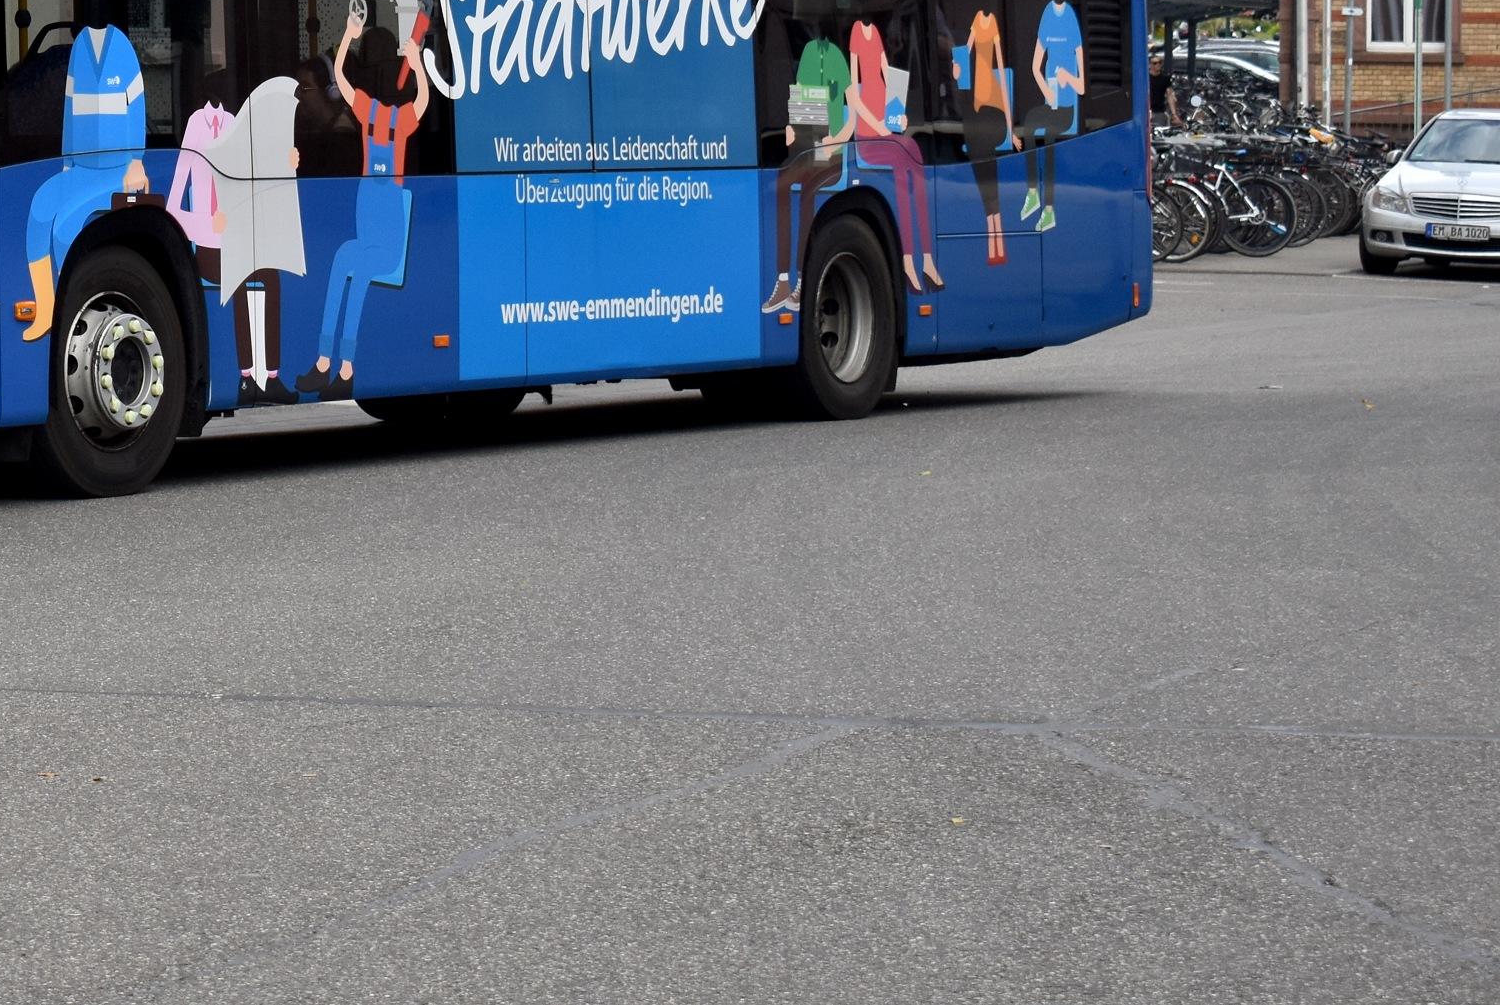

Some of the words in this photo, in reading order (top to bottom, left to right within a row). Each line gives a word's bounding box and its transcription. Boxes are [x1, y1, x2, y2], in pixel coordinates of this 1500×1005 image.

[494, 137, 518, 162] Wir
[523, 136, 582, 162] arbeiten
[585, 141, 609, 161] aus
[612, 135, 698, 161] Leidenschaft
[702, 135, 727, 160] und
[515, 174, 611, 208] Überzeugung
[616, 176, 635, 201] für
[638, 176, 658, 201] die
[662, 176, 712, 207] Region.
[1433, 226, 1445, 236] EM
[1451, 227, 1463, 236] BA
[1466, 228, 1488, 239] 1020
[501, 286, 723, 324] www.swe-emmendingen.de
